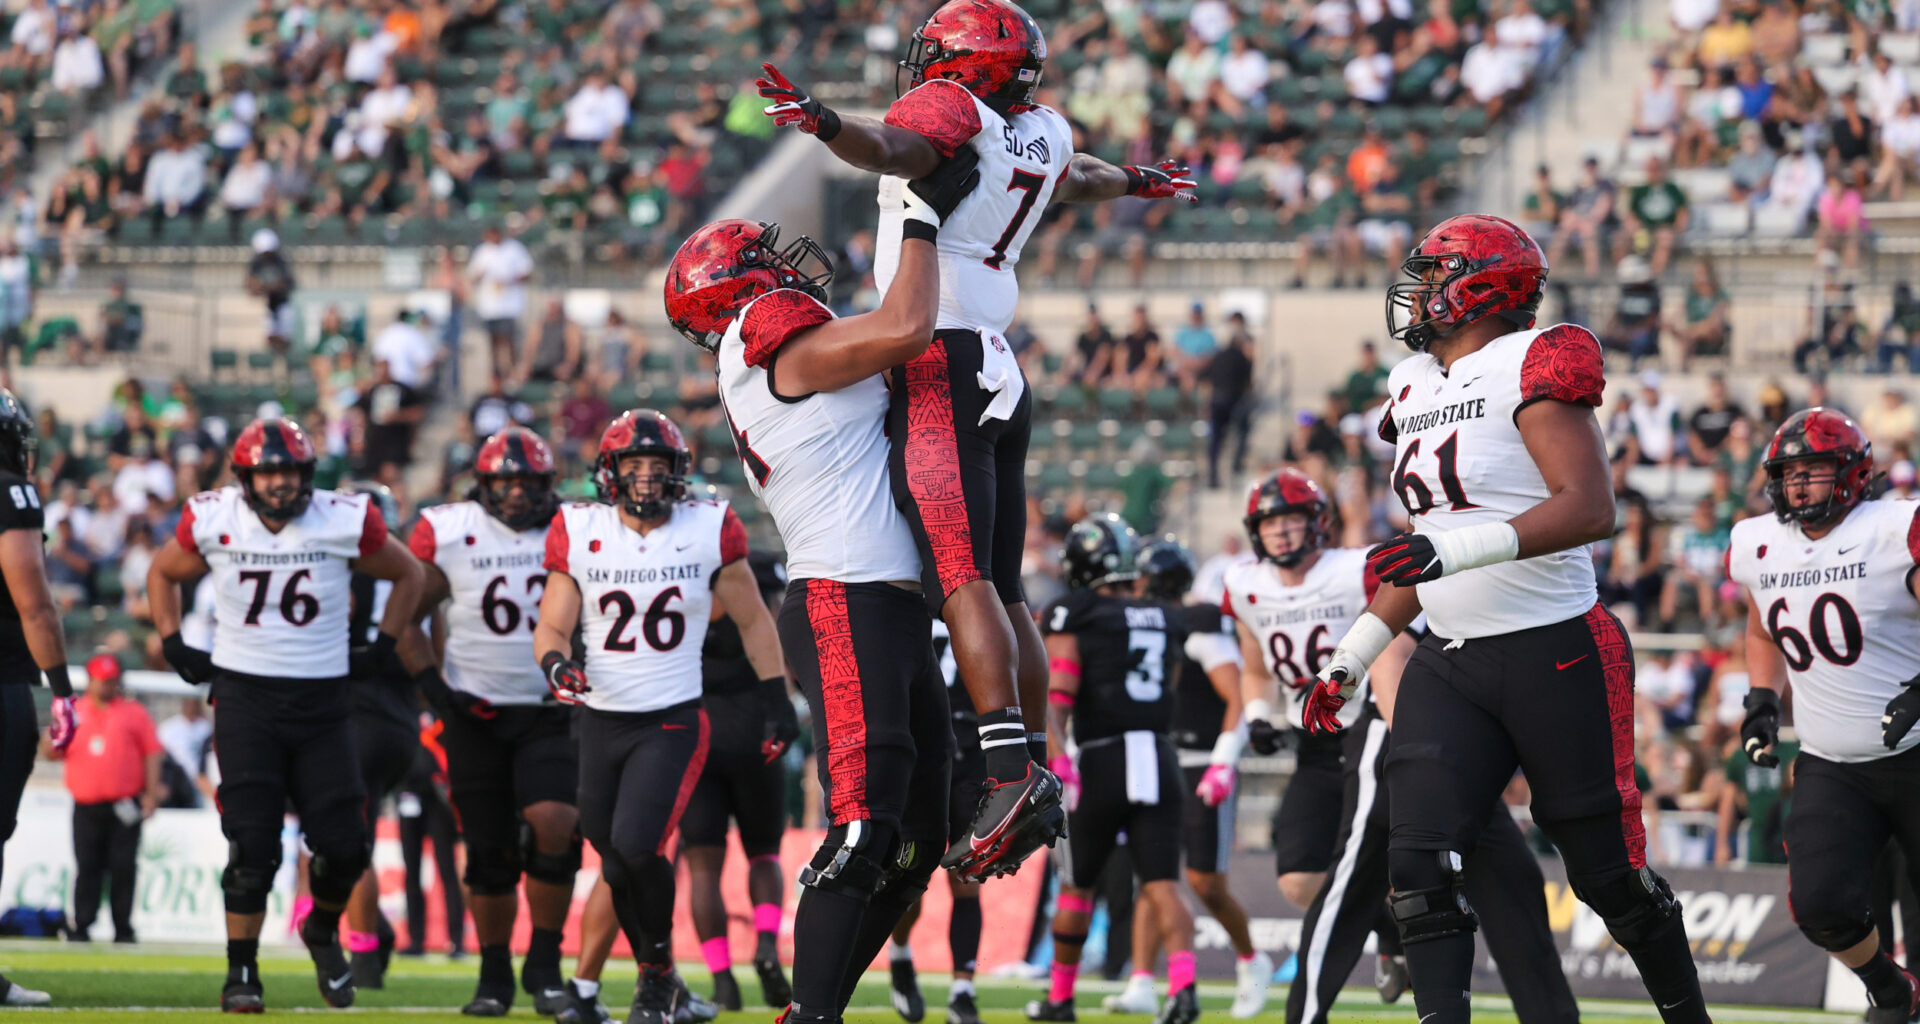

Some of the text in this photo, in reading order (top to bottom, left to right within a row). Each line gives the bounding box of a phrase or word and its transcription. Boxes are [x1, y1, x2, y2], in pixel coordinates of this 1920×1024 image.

[983, 167, 1047, 270] 7
[1406, 409, 1441, 435] DIEGO
[1440, 398, 1486, 426] STATE
[1393, 428, 1482, 516] 61
[251, 552, 290, 564] DIEGO
[293, 551, 327, 564] STATE
[587, 563, 702, 584] SAN DIEGO STATE
[1759, 561, 1867, 591] SAN DIEGO STATE
[239, 569, 320, 626] 76
[481, 574, 548, 636] 63
[600, 585, 686, 652] 26
[1269, 624, 1336, 690] 86
[1768, 592, 1863, 672] 60
[1125, 629, 1167, 702] 3
